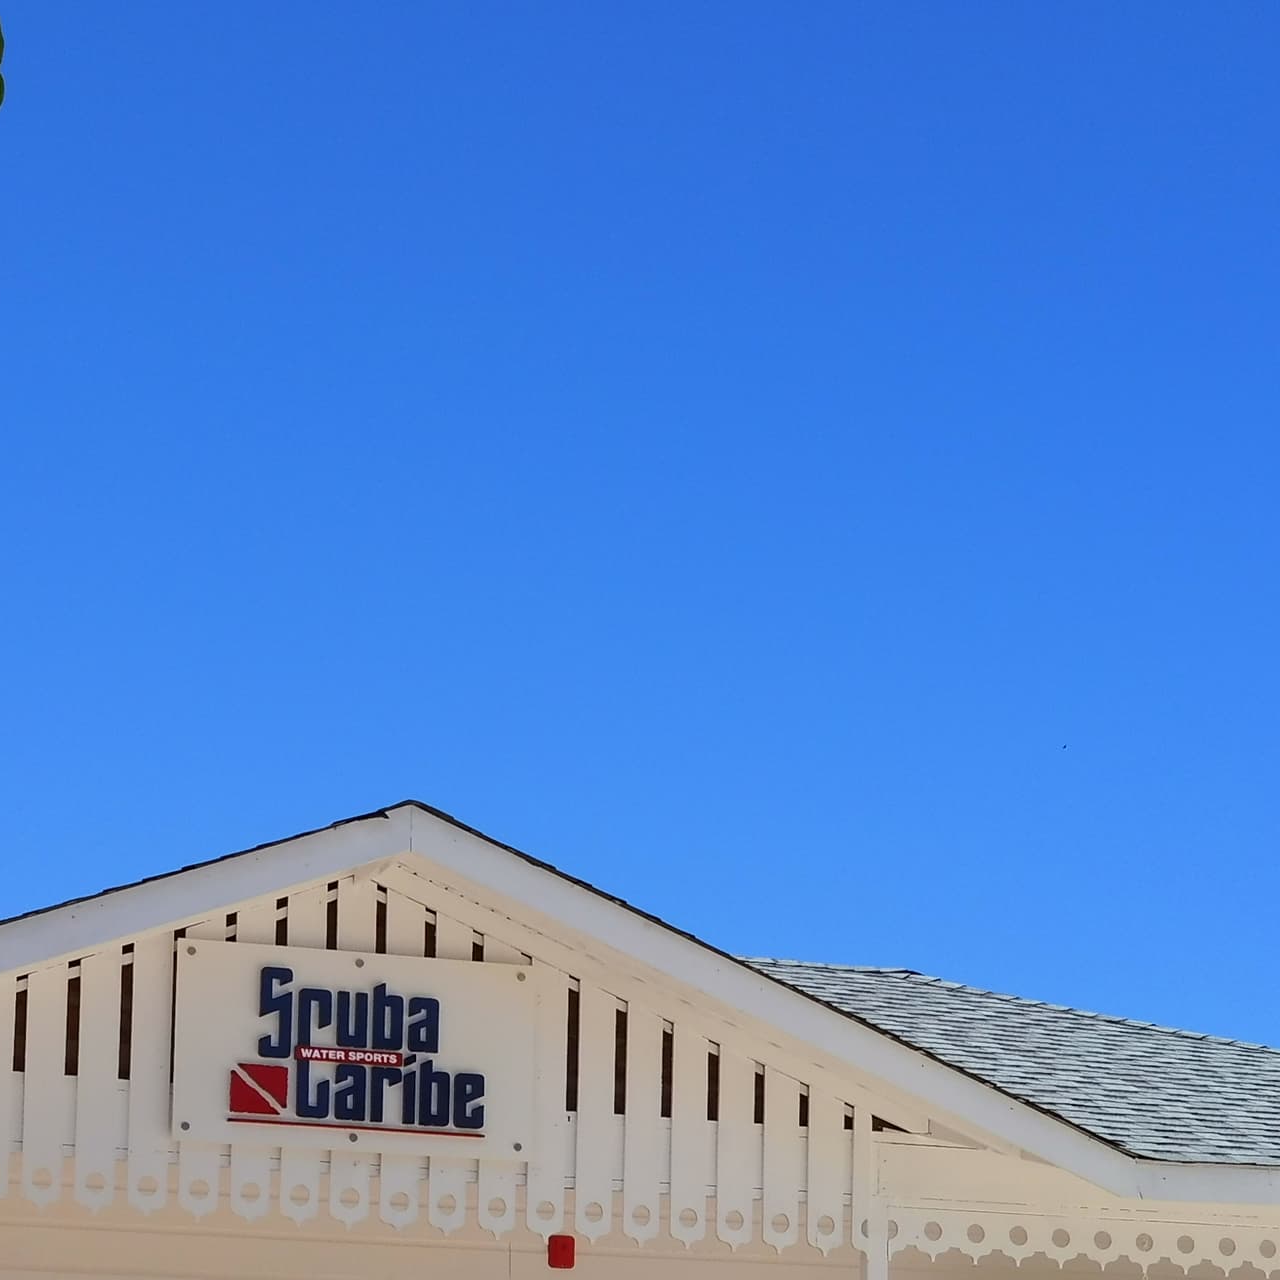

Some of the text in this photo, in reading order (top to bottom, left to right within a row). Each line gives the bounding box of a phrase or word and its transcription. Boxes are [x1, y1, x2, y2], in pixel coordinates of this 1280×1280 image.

[258, 966, 440, 1059] Scuba
[300, 1047, 398, 1064] WATER SPORTS
